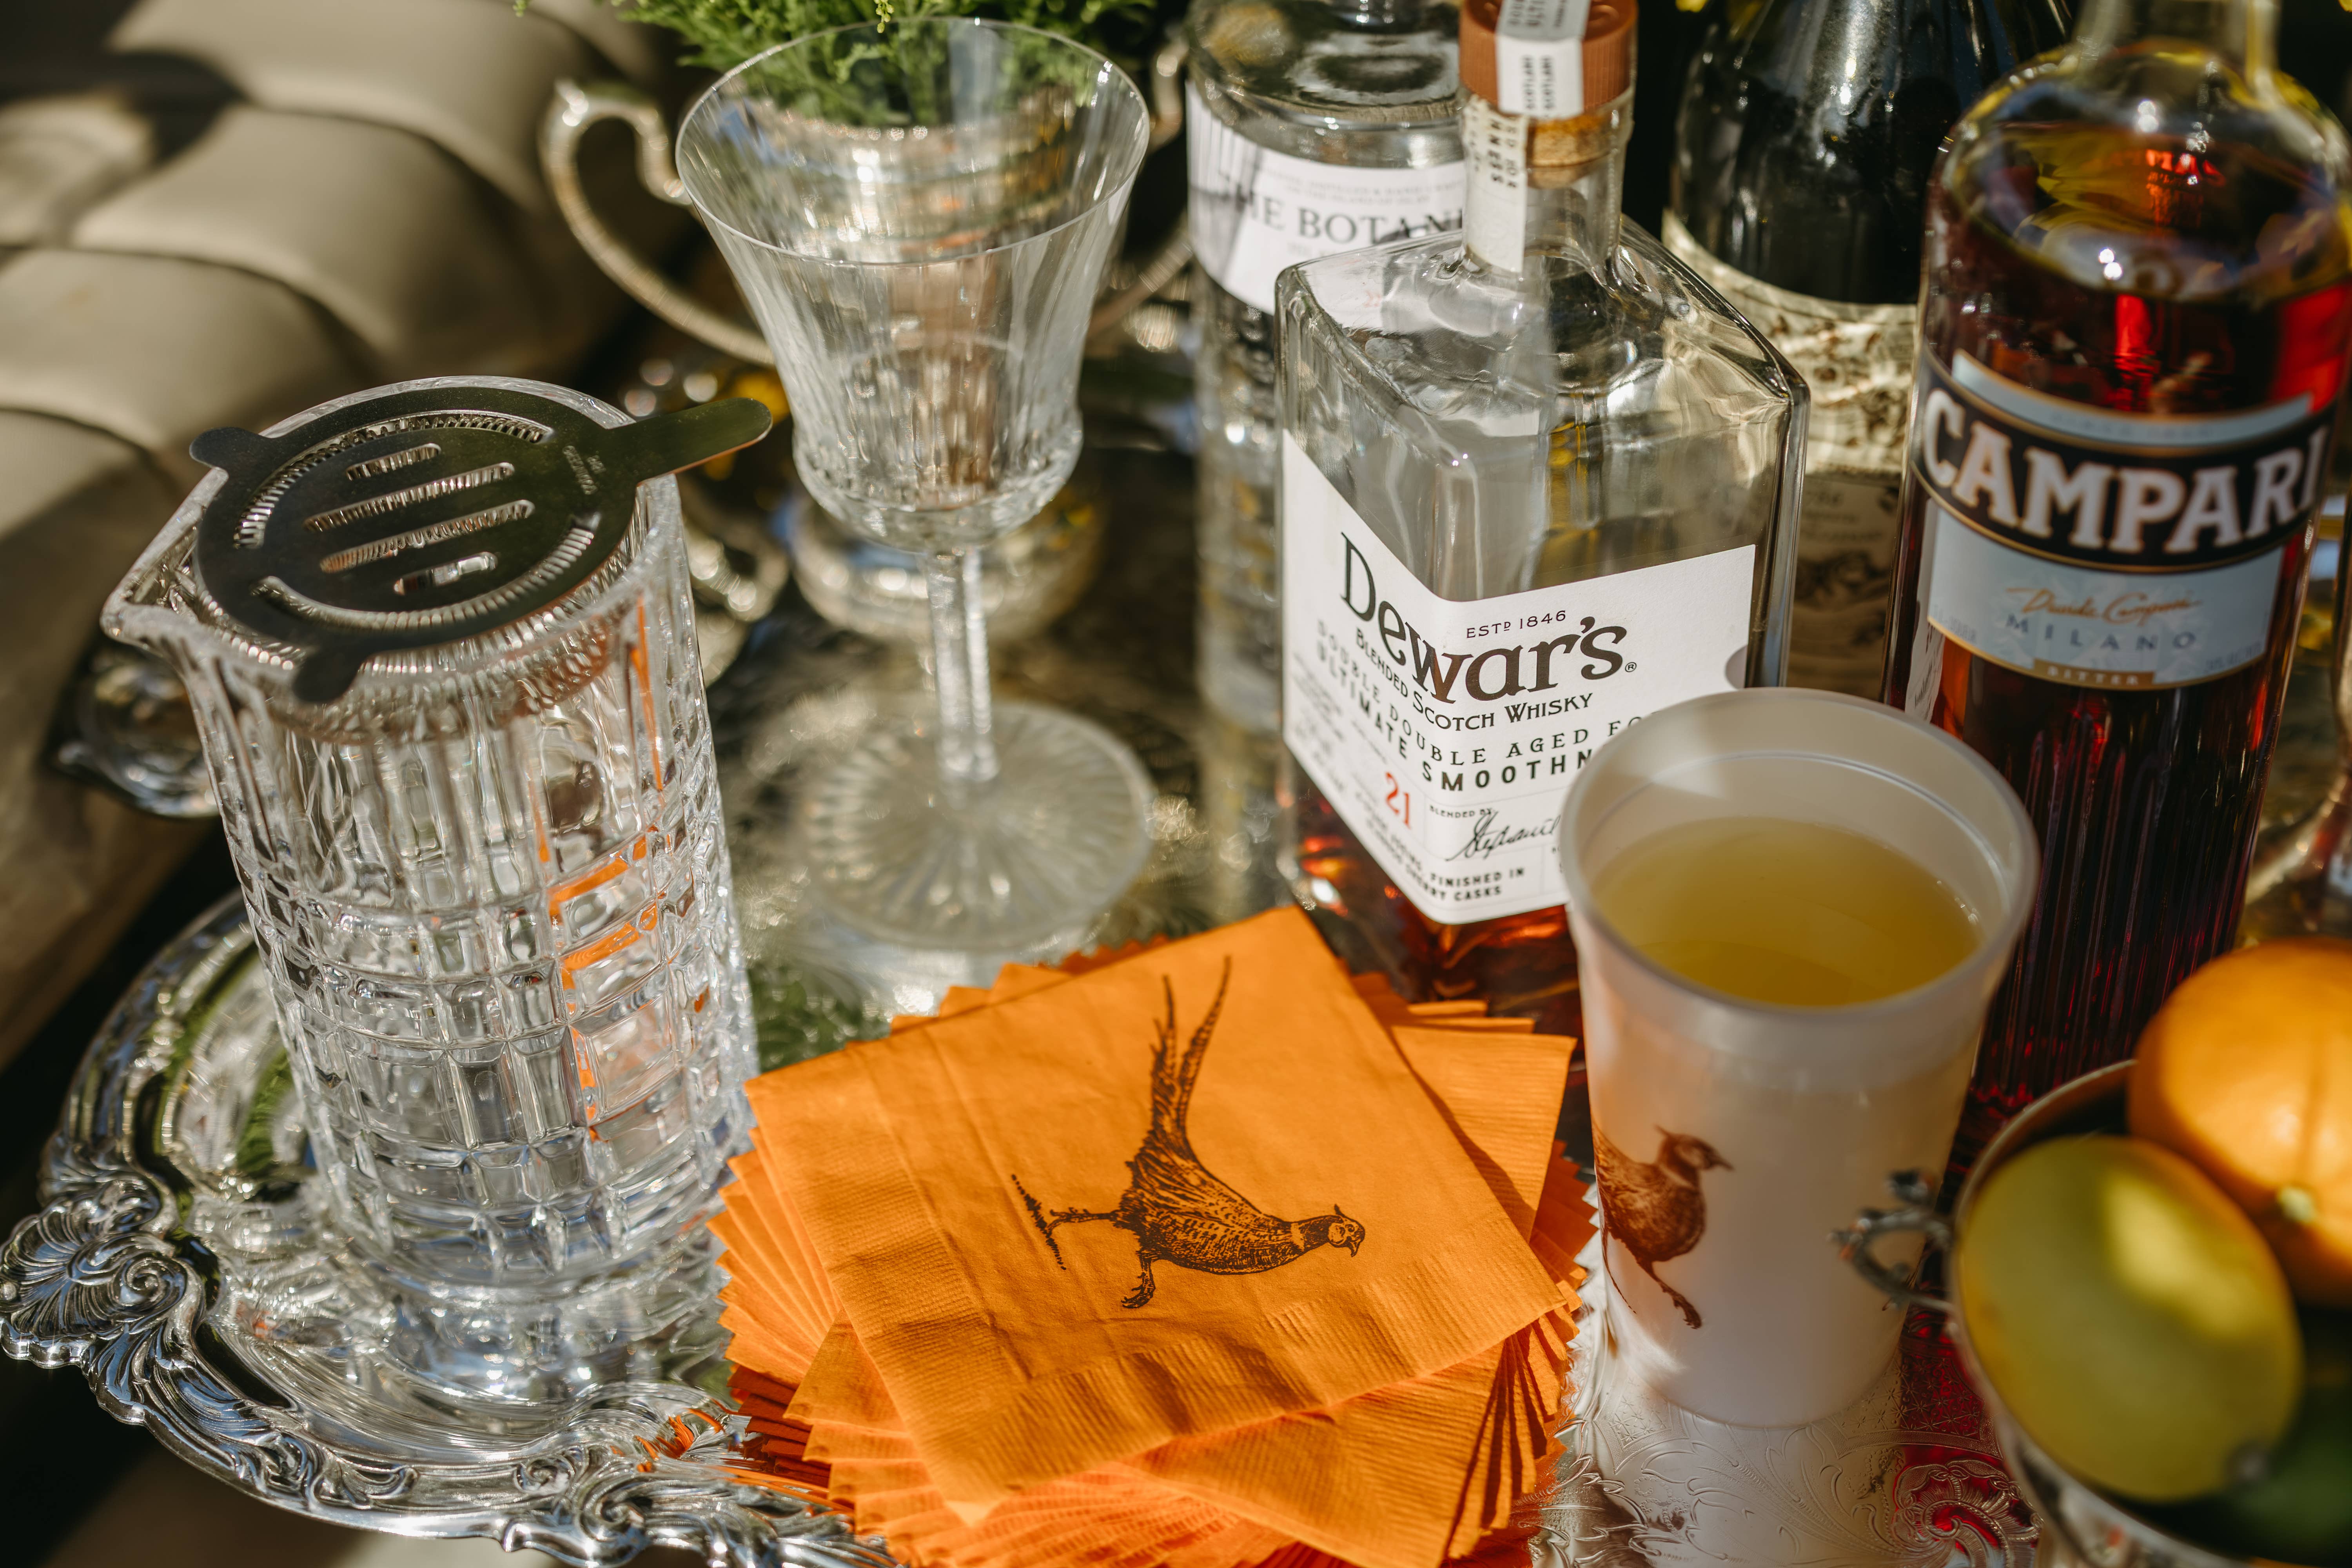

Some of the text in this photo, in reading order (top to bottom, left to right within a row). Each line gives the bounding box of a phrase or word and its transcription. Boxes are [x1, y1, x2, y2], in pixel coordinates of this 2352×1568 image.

[1297, 207, 1463, 244] BOTAN
[1923, 388, 2328, 555] CAMPARI
[1519, 610, 1566, 629] 1846
[2005, 614, 2196, 650] MILANO
[1318, 619, 1381, 704] DOUBLE
[1390, 703, 1486, 766] DOUBLE
[1506, 729, 1589, 759] AGED
[1356, 628, 1408, 698] BLENDED
[1413, 690, 1495, 731] SCOTCH
[1504, 692, 1593, 723] WHISKY
[2047, 664, 2139, 686] BITTER
[1317, 640, 1408, 760] ULTIMATE
[1421, 748, 1593, 792] SMOOTHN
[1385, 771, 1411, 830] 21
[1429, 805, 1476, 818] BLENDED
[1430, 867, 1525, 887] FINISHED IN
[1454, 886, 1503, 901] CASKS
